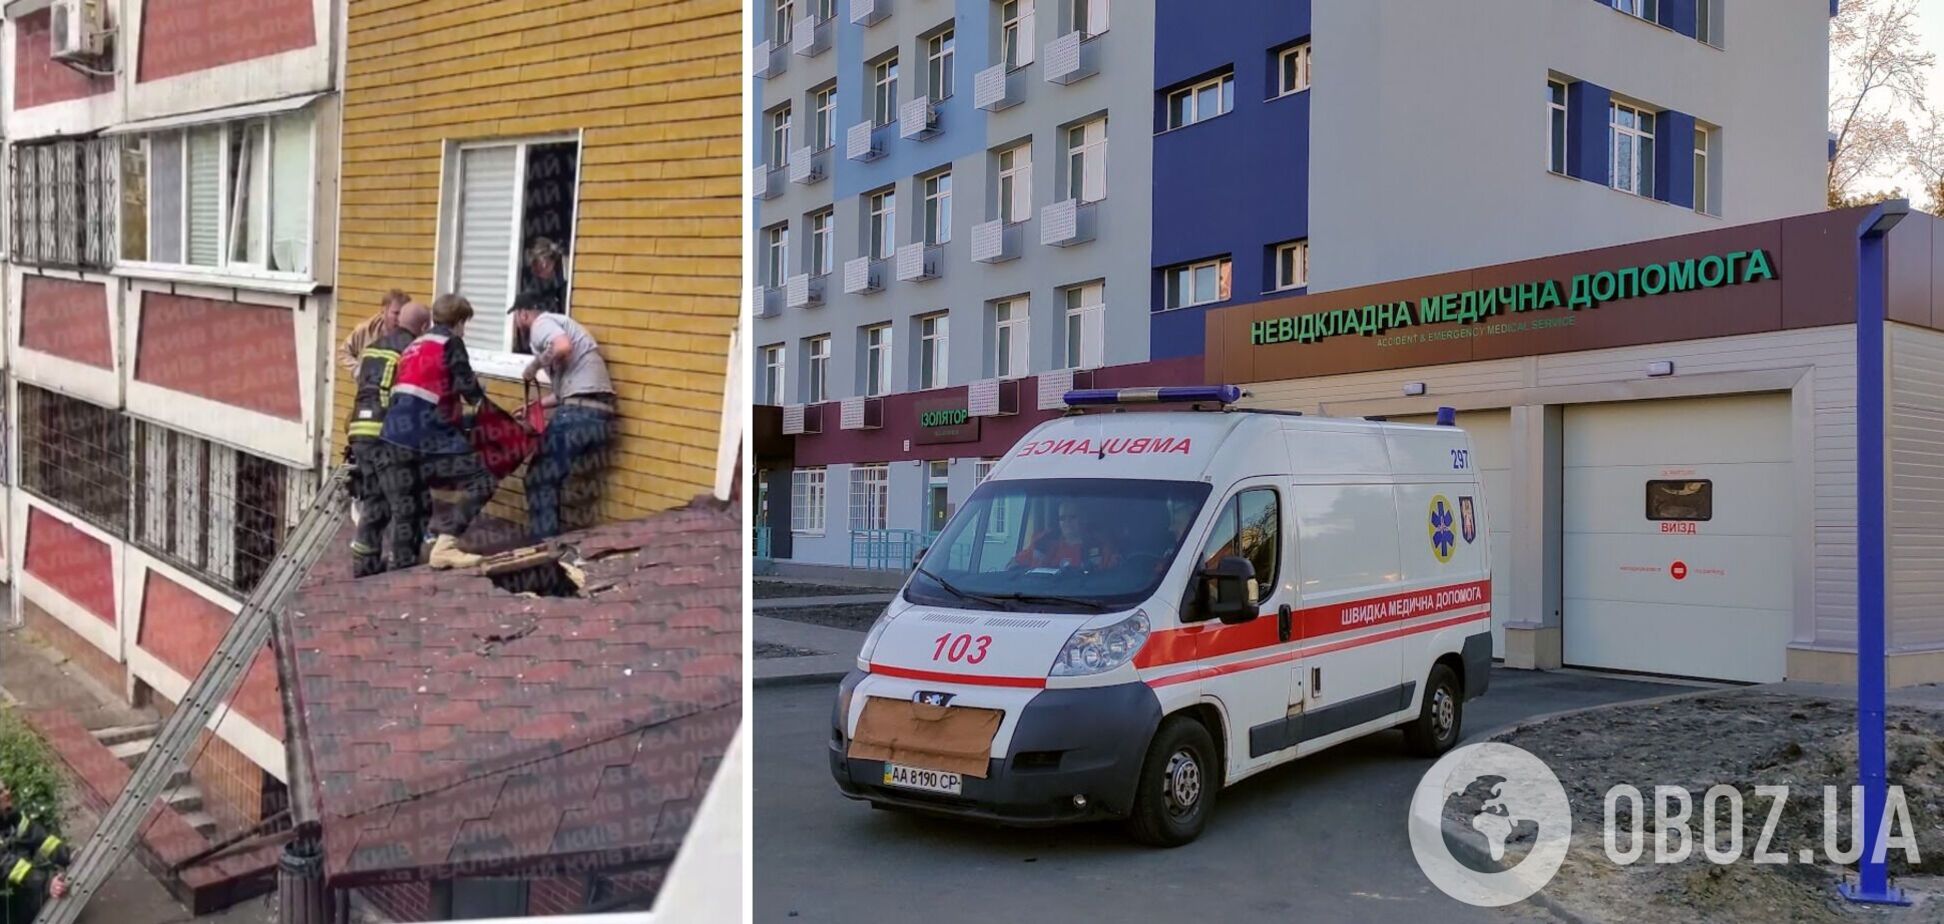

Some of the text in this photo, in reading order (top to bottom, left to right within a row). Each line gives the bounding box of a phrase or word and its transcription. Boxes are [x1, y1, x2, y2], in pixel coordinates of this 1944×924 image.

[1251, 248, 1773, 345] НЕВІДКЛАДНА МЕДИЧНА ДОПОМОГА
[1377, 334, 1417, 347] ACCIDENT
[1428, 326, 1484, 342] EMERGENCY
[921, 409, 968, 427] ІЗОЛЯТОР
[1451, 449, 1468, 469] 297
[1341, 586, 1482, 625] ШВИДКА МЕДИЧНА ДОПОМОГА
[932, 632, 993, 665] 103
[892, 766, 908, 783] AA
[910, 770, 937, 788] 8190
